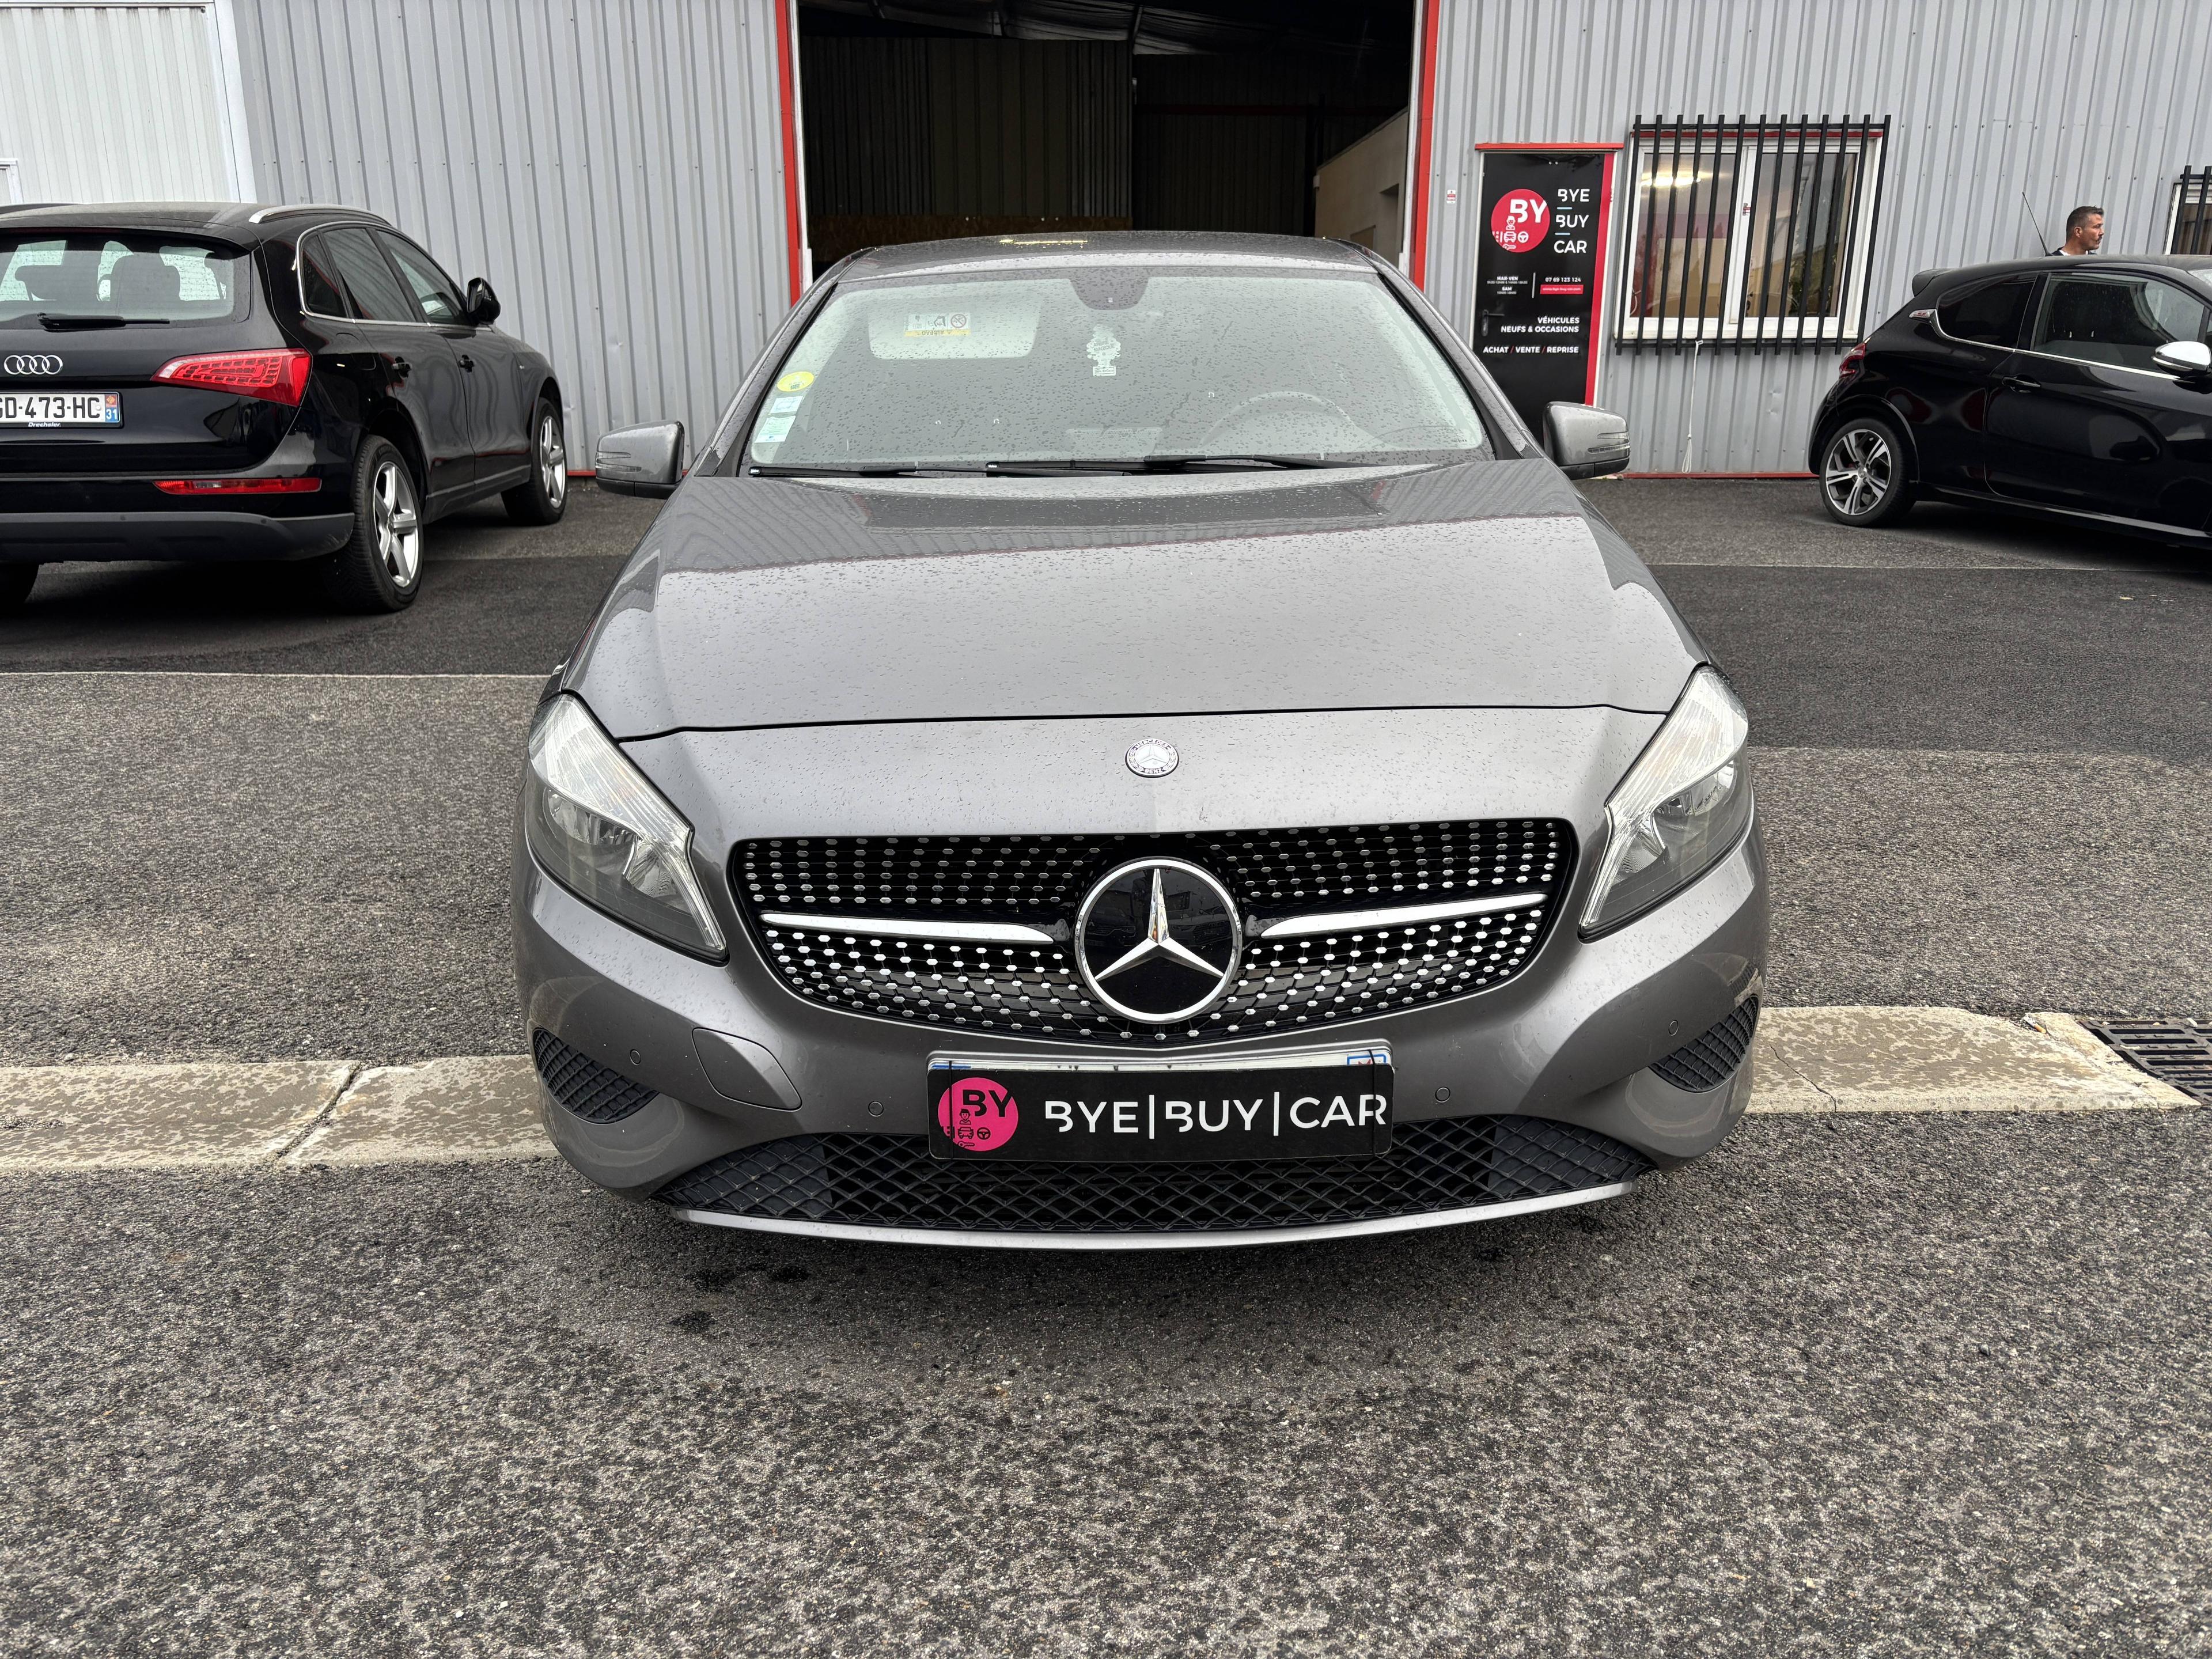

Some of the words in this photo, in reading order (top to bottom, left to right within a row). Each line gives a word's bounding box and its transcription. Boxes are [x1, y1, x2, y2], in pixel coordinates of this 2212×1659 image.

[1558, 188, 1590, 202] BYE
[1510, 199, 1547, 224] BY
[1556, 214, 1589, 228] BUY
[1554, 240, 1587, 253] CAR
[1537, 316, 1580, 324] VÉHICULES
[0, 397, 100, 419] D-473-HC
[106, 409, 118, 420] 31
[963, 1089, 1012, 1117] BY
